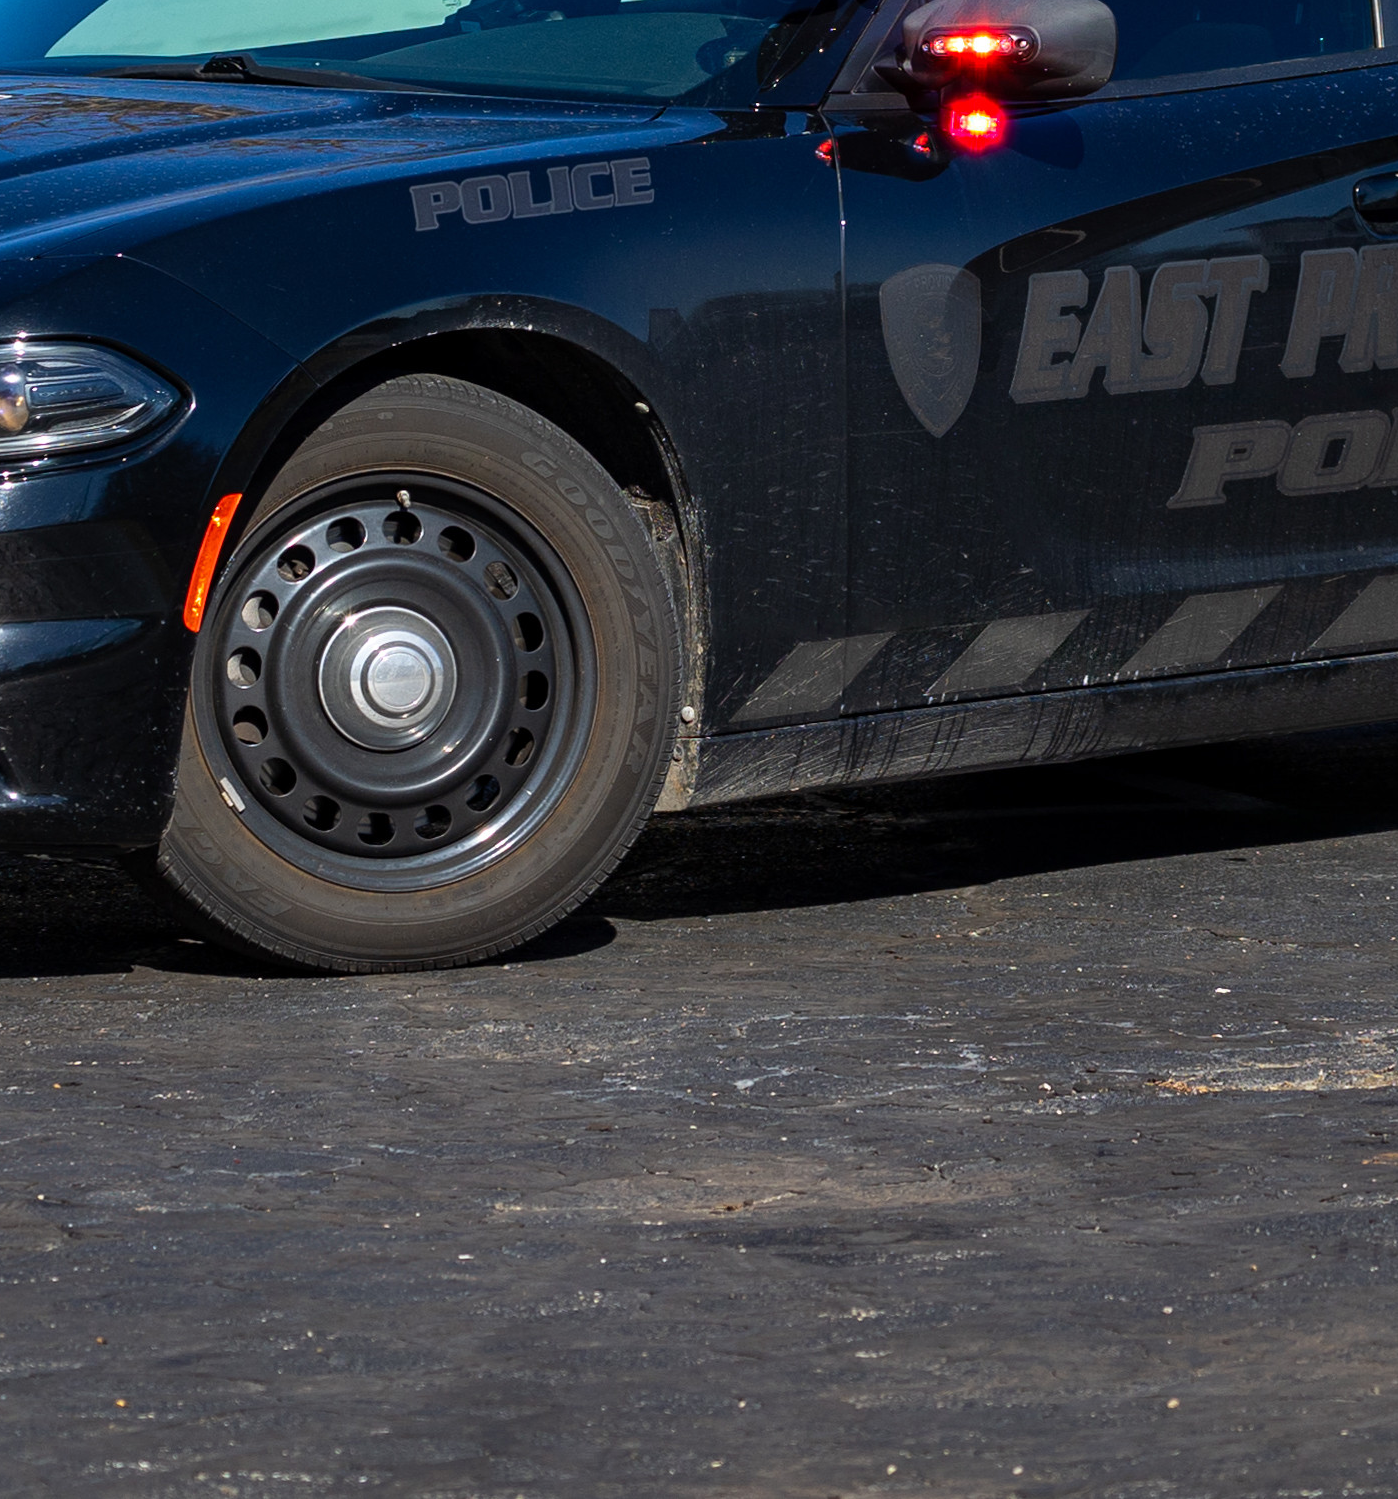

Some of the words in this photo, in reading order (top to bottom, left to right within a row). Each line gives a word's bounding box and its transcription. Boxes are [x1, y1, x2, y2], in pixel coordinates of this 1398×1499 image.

[409, 156, 655, 232] POLICE
[1007, 254, 1270, 405] EAST
[520, 451, 658, 775] GOODYEAR
[173, 800, 293, 917] EAGL
